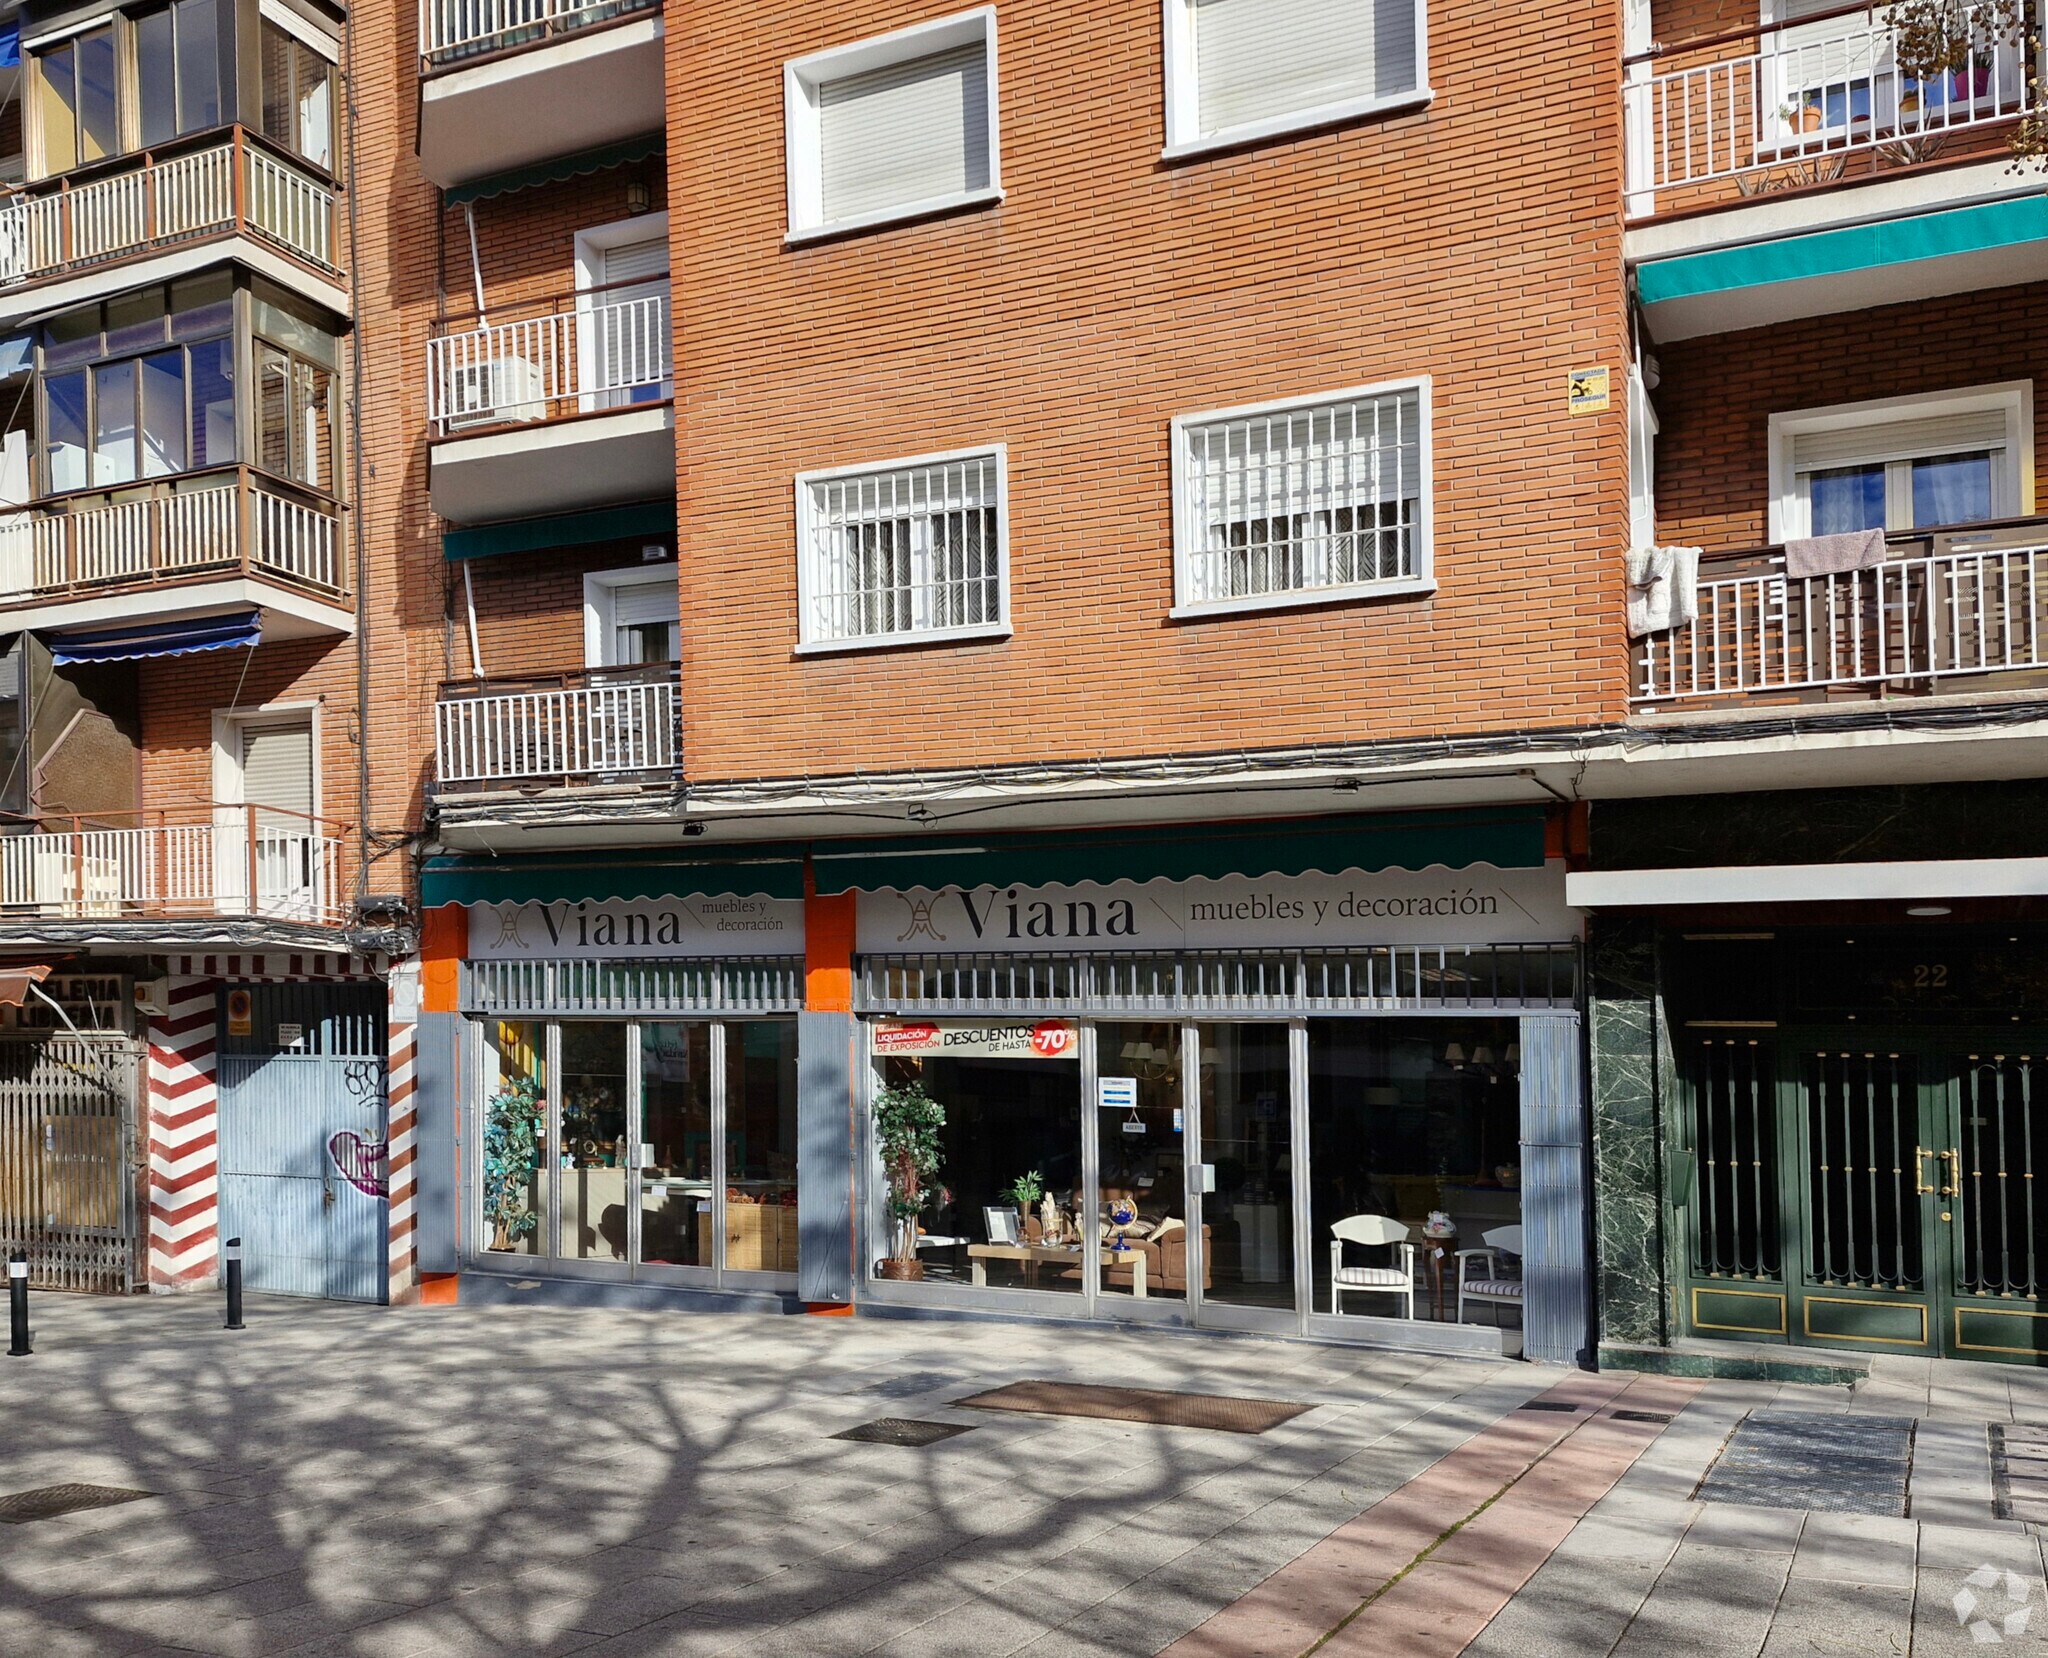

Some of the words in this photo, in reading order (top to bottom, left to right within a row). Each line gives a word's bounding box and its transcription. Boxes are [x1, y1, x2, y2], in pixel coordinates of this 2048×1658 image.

[1571, 394, 1606, 403] PROSEGUR
[702, 899, 756, 914] muebles
[758, 902, 767, 917] y
[957, 889, 1140, 939] Viana
[1190, 894, 1304, 921] muebles
[1313, 900, 1329, 926] y
[1338, 888, 1499, 918] decoración
[538, 903, 685, 947] Viana
[716, 917, 784, 932] decoración
[1913, 964, 1948, 987] 22
[877, 1029, 927, 1042] LIQUIDACIÓN
[878, 1022, 902, 1032] GRAN
[944, 1024, 1035, 1046] DESCUENTOS
[877, 1044, 888, 1053] DE
[890, 1040, 940, 1051] EXPOSICIÓN
[988, 1043, 1000, 1052] DE
[1003, 1040, 1031, 1050] HASTA
[1034, 1028, 1078, 1050] -70%
